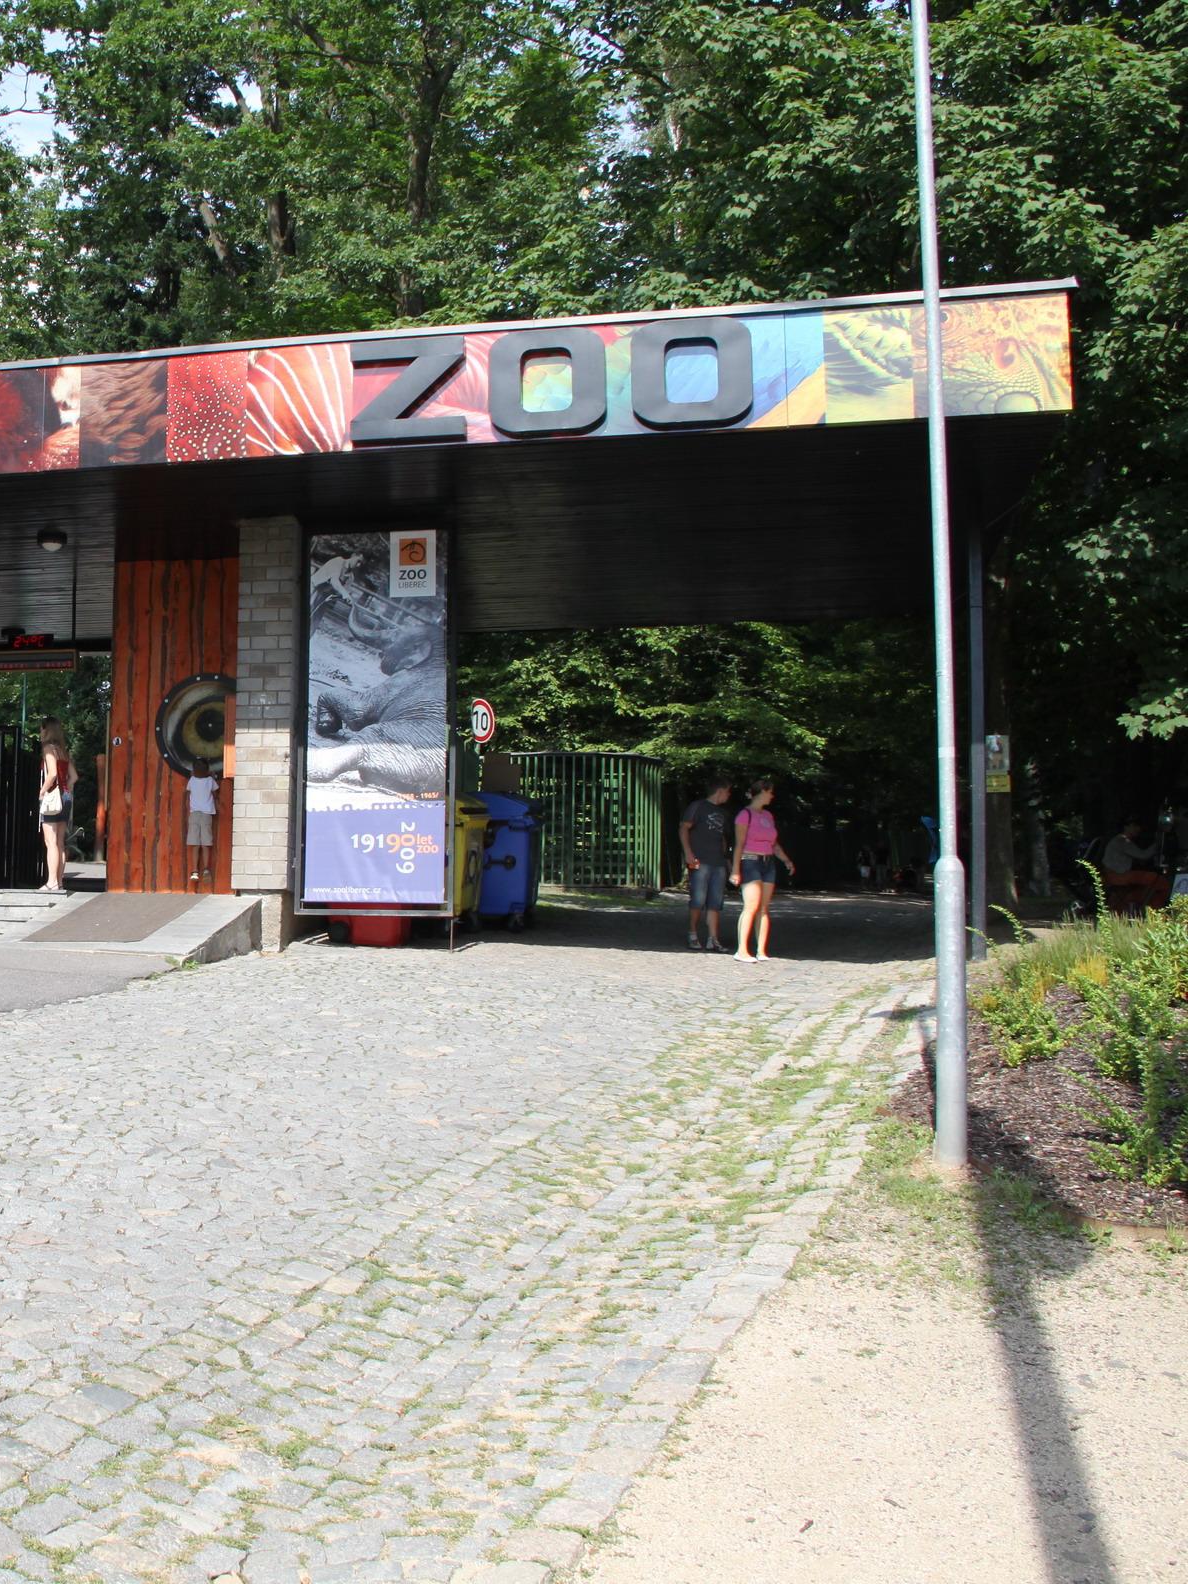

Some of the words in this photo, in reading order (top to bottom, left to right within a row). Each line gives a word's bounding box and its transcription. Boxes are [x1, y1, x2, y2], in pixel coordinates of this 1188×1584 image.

[350, 316, 753, 443] ZOO
[398, 569, 427, 580] ZOO
[398, 581, 428, 589] LIBEREC
[473, 710, 489, 731] 10
[416, 833, 433, 845] let
[416, 845, 439, 854] zoo
